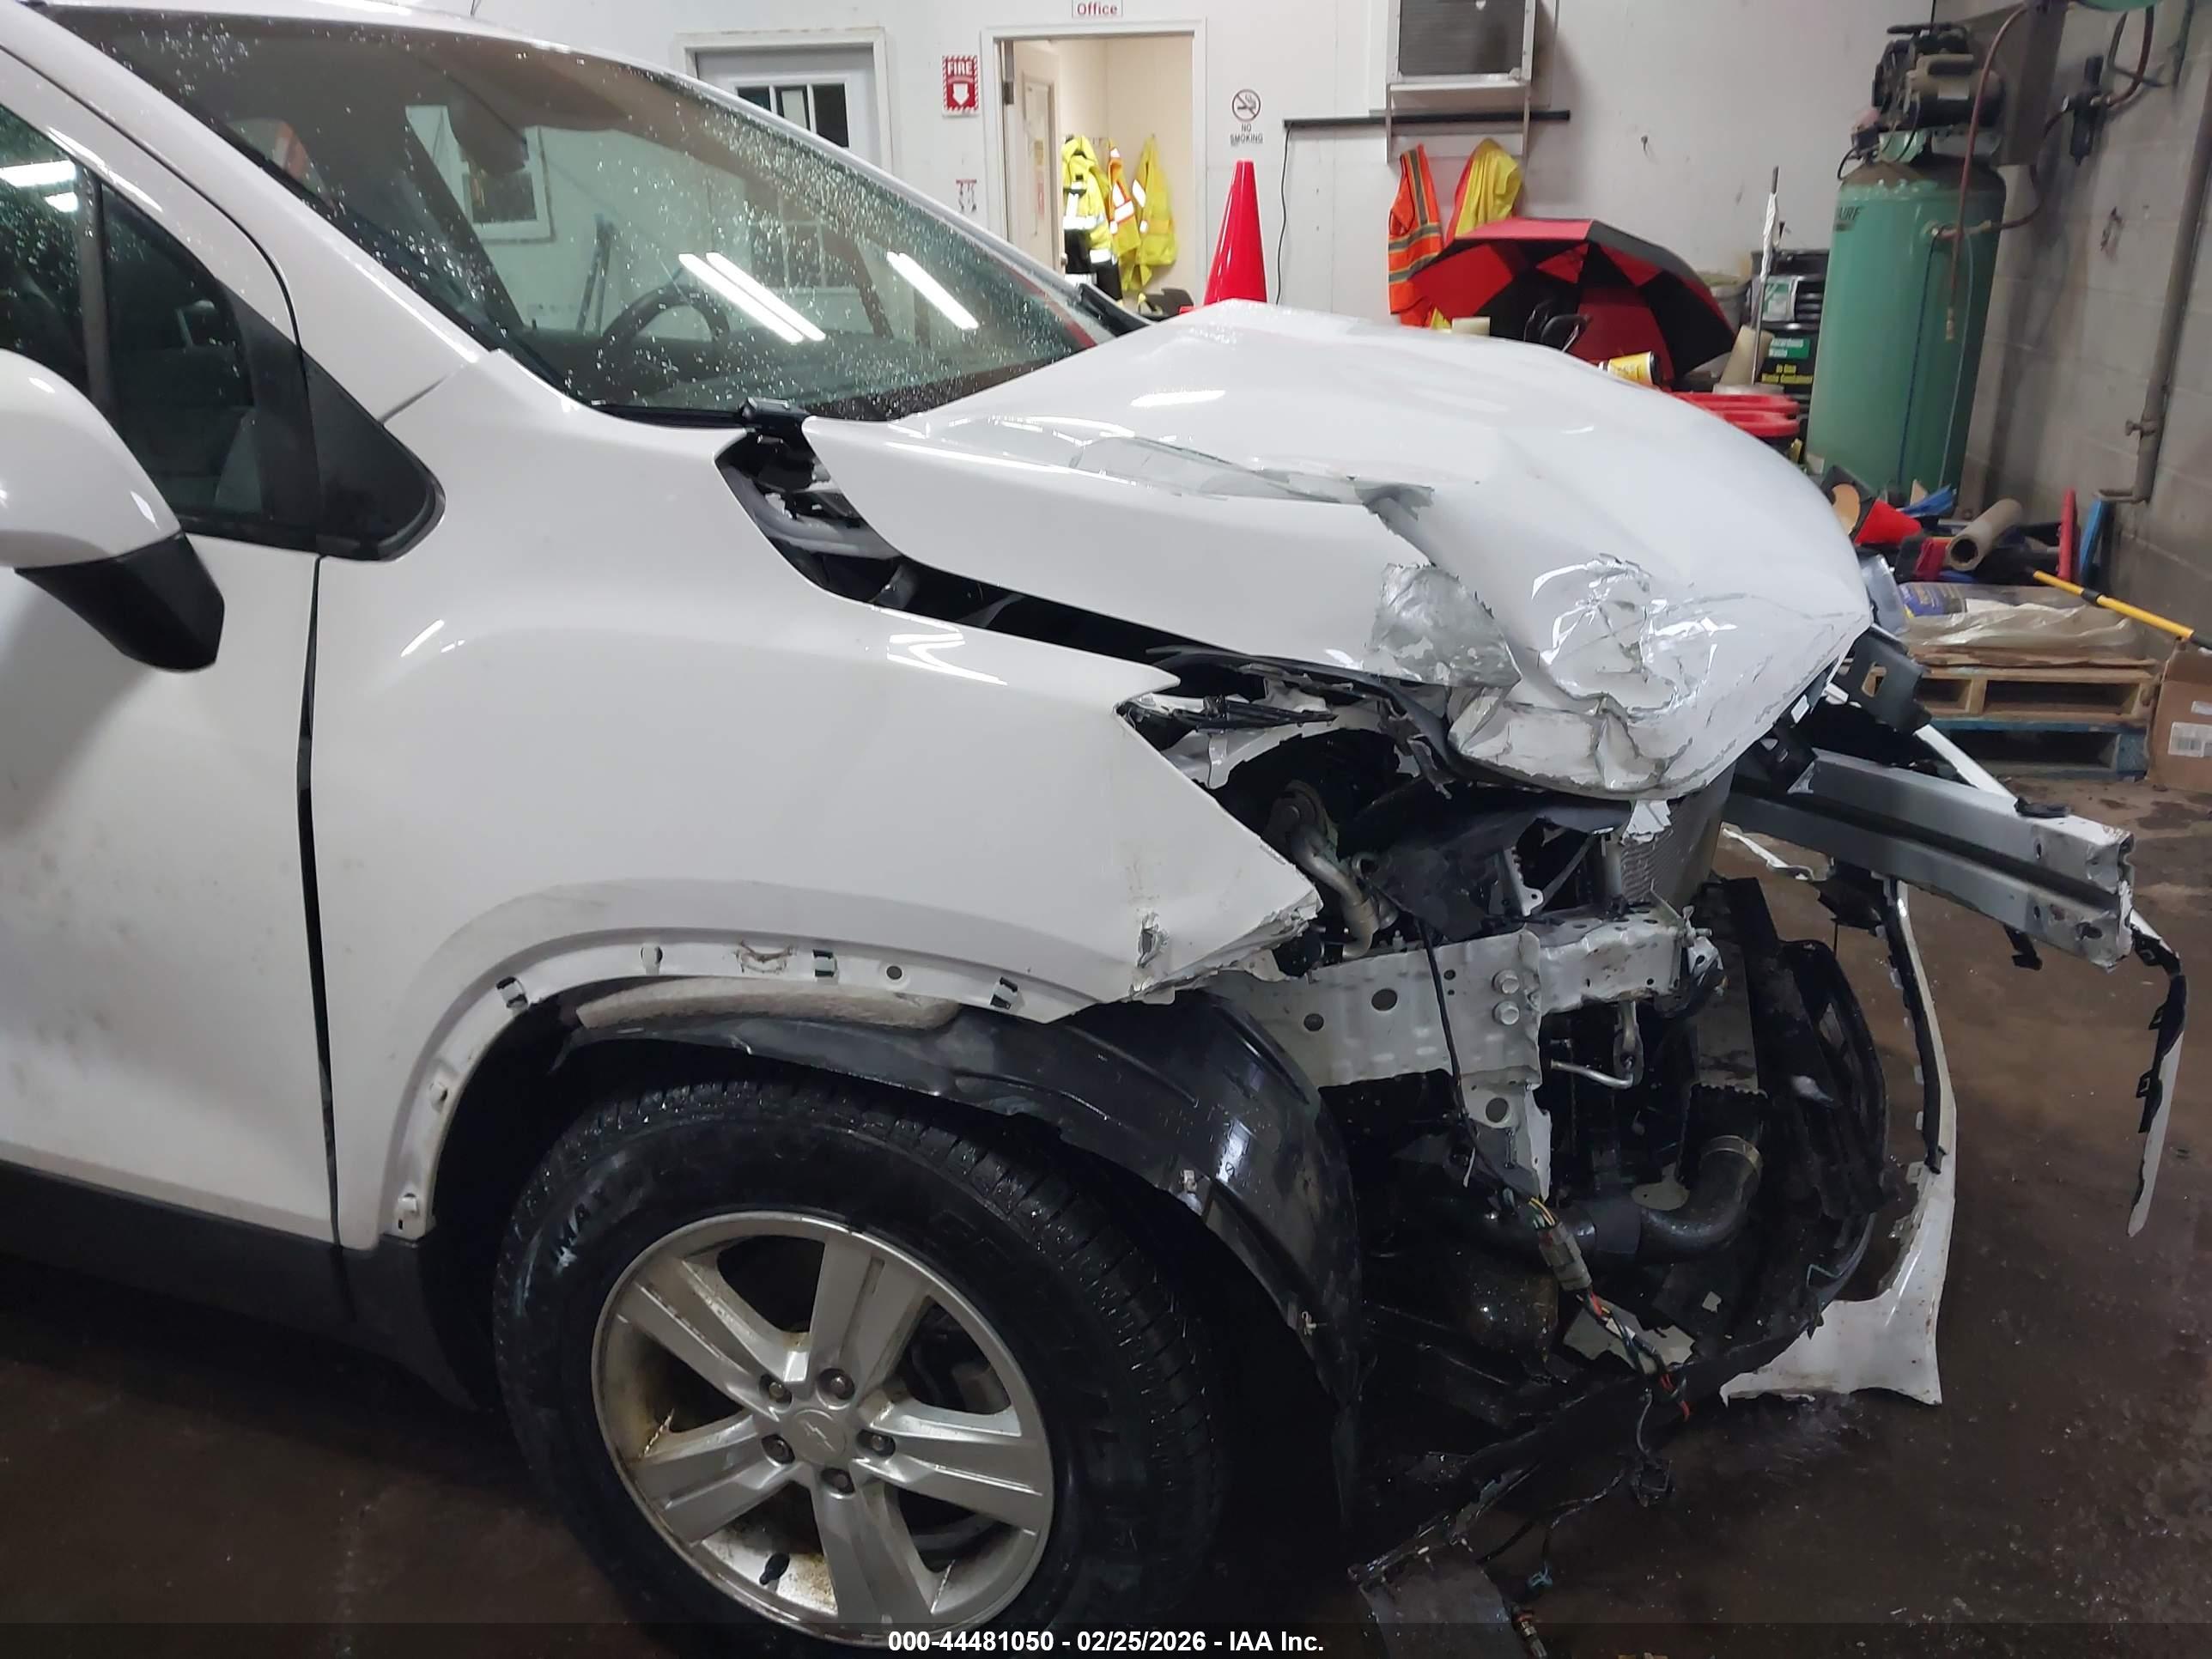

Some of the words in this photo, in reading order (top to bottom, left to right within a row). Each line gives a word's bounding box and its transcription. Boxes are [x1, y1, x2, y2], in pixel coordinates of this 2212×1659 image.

[1077, 3, 1118, 16] Office
[947, 61, 973, 76] FIRE
[1241, 123, 1252, 132] NO
[1230, 132, 1264, 145] SMOKING
